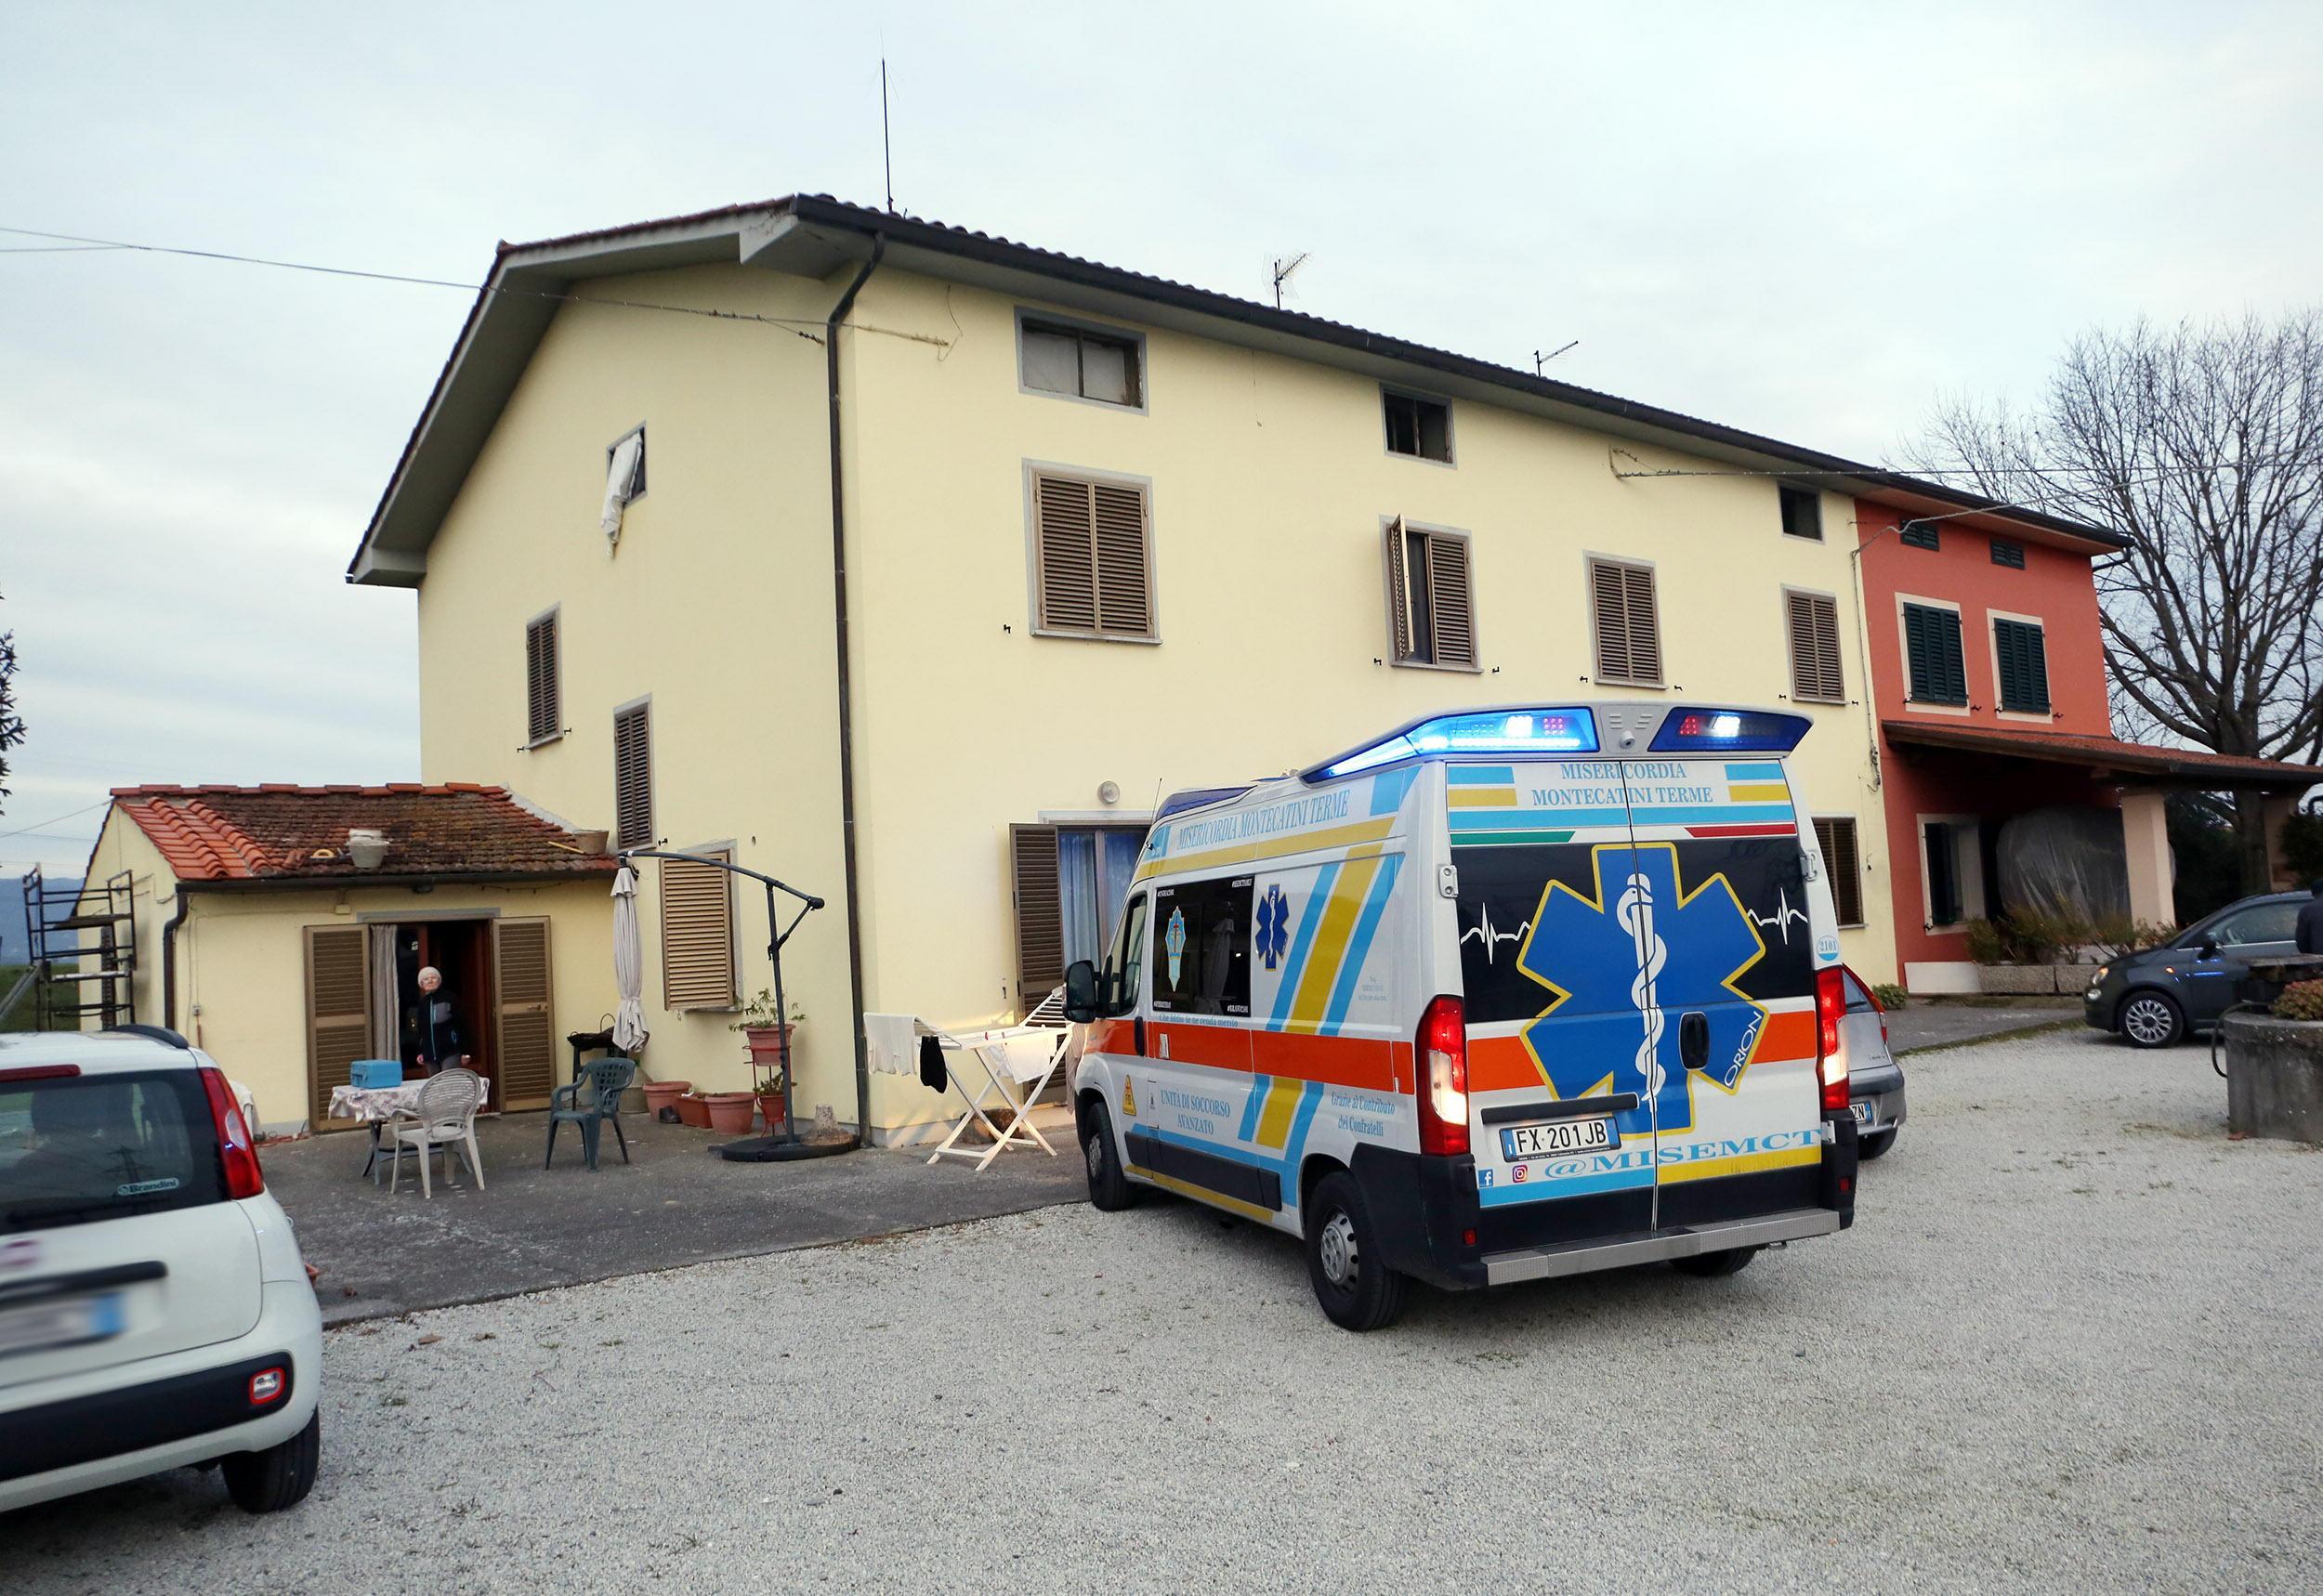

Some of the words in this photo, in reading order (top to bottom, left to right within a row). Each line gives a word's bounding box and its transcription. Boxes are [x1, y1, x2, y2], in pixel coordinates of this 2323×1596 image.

[1560, 763, 1686, 779] MISERICORDIA
[1531, 787, 1653, 806] MONTECATINI
[1656, 787, 1713, 804] TERME
[1177, 818, 1238, 850] MISERICORDIA
[1238, 799, 1309, 838] MONTECATINI
[1309, 790, 1351, 824] TERME
[1818, 940, 1837, 951] 2101
[1724, 1011, 1763, 1087] ORION
[1182, 1093, 1189, 1107] DI
[1190, 1095, 1230, 1118] SOCCORSO
[1332, 1092, 1350, 1107] Grazie
[1359, 1096, 1395, 1115] Contributo
[1177, 1115, 1214, 1135] AVANZATO
[1338, 1115, 1349, 1130] dei
[1349, 1116, 1384, 1136] Confratelli
[1516, 1129, 1542, 1153] FX
[1545, 1119, 1822, 1178] @MISEMCT
[129, 1180, 177, 1192] Brandini
